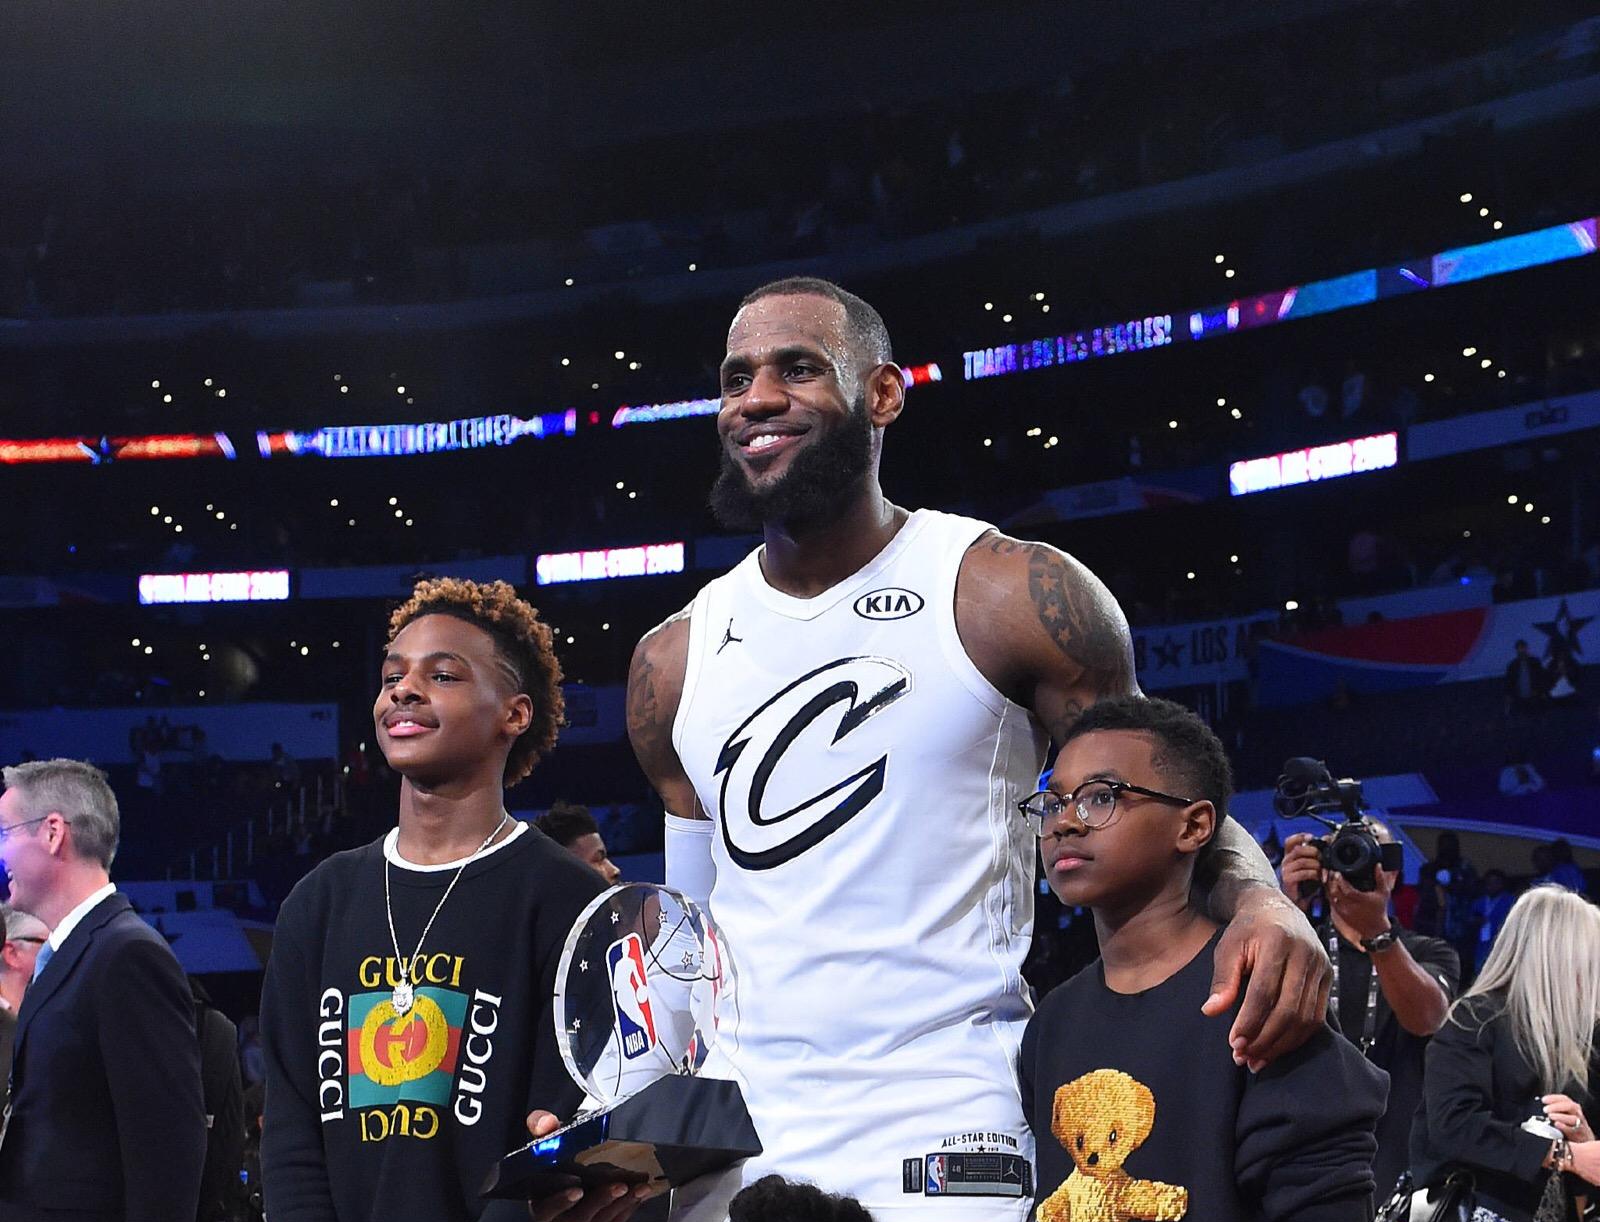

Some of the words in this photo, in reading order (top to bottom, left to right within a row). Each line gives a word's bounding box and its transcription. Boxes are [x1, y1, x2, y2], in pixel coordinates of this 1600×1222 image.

[866, 595, 911, 613] KIA
[359, 953, 465, 988] GUCCI
[318, 987, 344, 1123] GUCCI
[454, 988, 503, 1126] GUCCI
[625, 1030, 645, 1056] NBA
[941, 1132, 984, 1149] ALL-STAR
[987, 1132, 1018, 1149] EDITION
